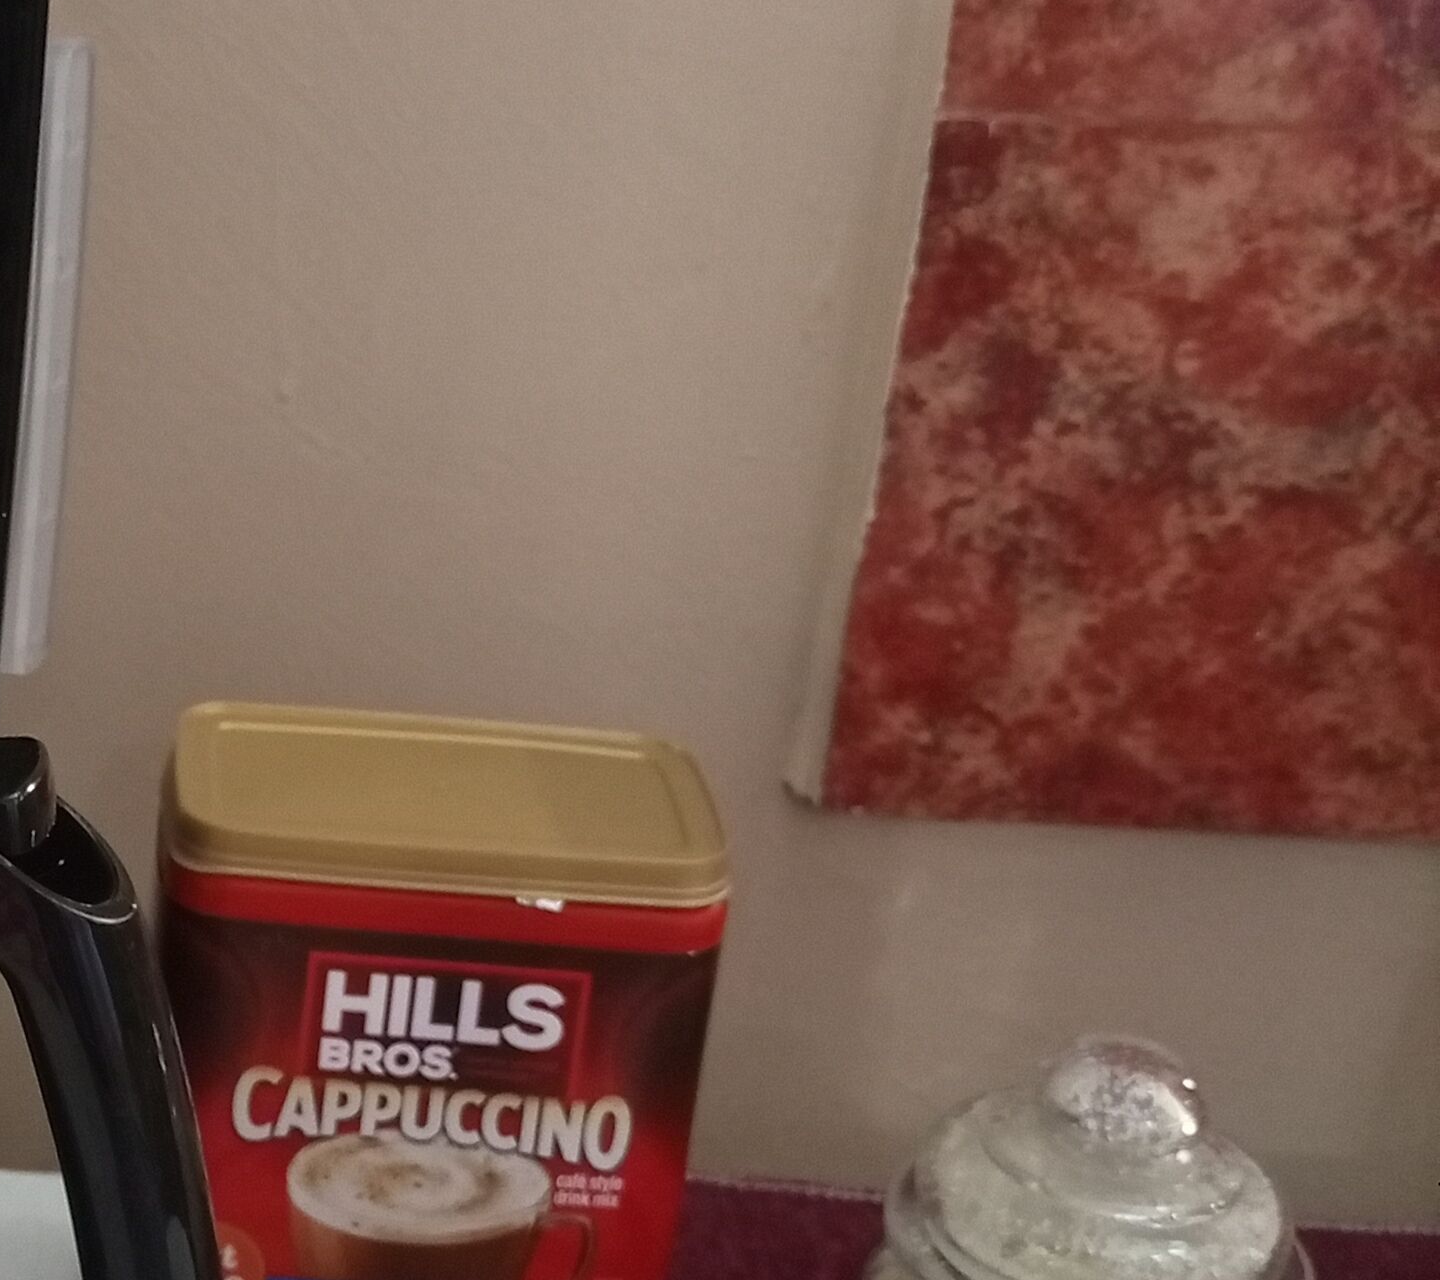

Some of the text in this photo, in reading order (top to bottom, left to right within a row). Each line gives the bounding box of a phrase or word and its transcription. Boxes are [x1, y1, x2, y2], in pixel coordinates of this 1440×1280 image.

[320, 968, 566, 1053] HILLS
[317, 1034, 459, 1082] BROS.
[231, 1064, 633, 1173] CAPPUCCINO
